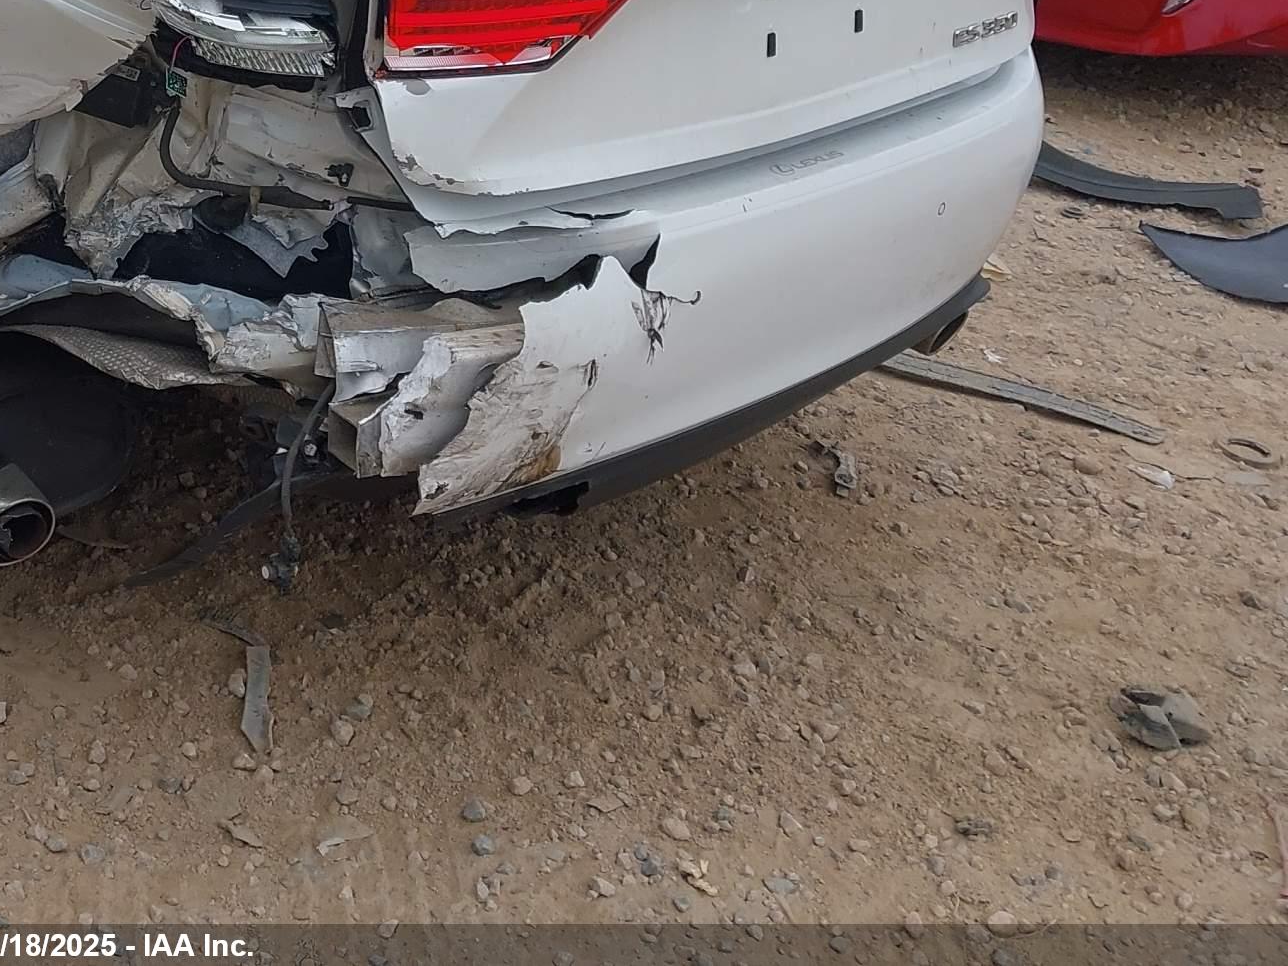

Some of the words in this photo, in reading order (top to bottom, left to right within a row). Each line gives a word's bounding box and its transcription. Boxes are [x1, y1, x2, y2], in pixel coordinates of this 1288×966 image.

[953, 24, 980, 47] ES
[981, 11, 1018, 38] 350
[791, 151, 844, 169] LEXUS
